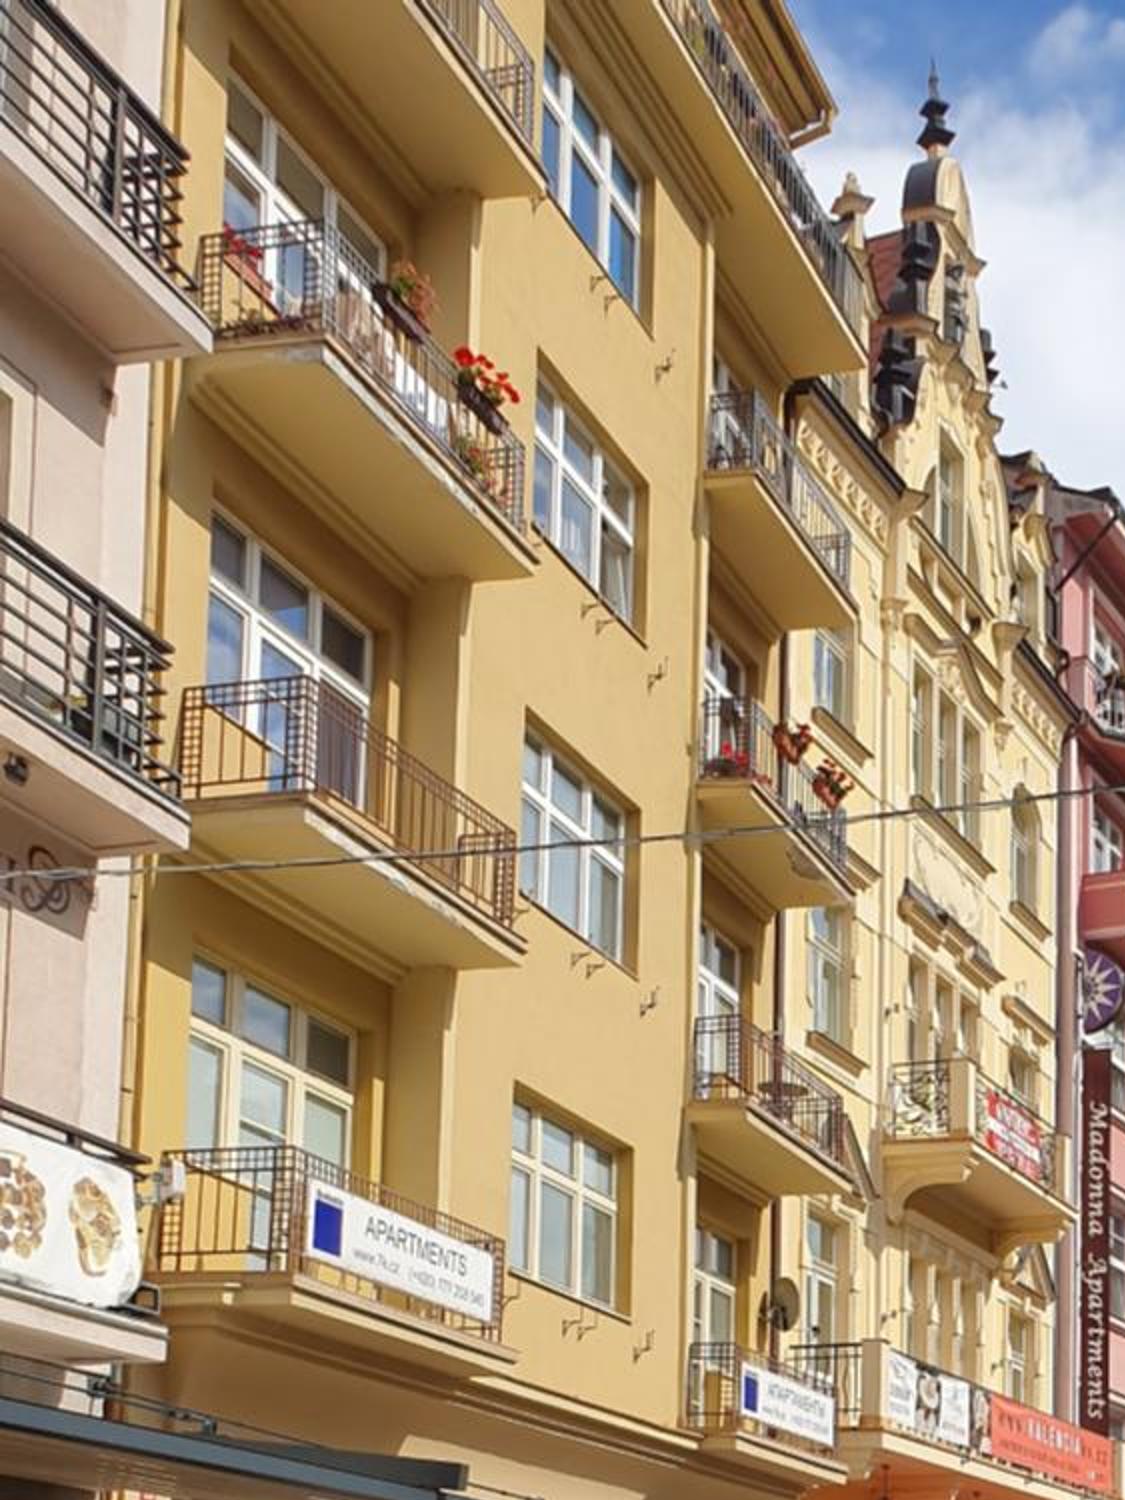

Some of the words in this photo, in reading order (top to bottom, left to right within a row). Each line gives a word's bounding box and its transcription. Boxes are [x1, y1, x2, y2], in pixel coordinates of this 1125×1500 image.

[1088, 1101, 1109, 1236] Madonna
[365, 1216, 468, 1277] APARTMENTS
[1083, 1252, 1108, 1419] Apartments
